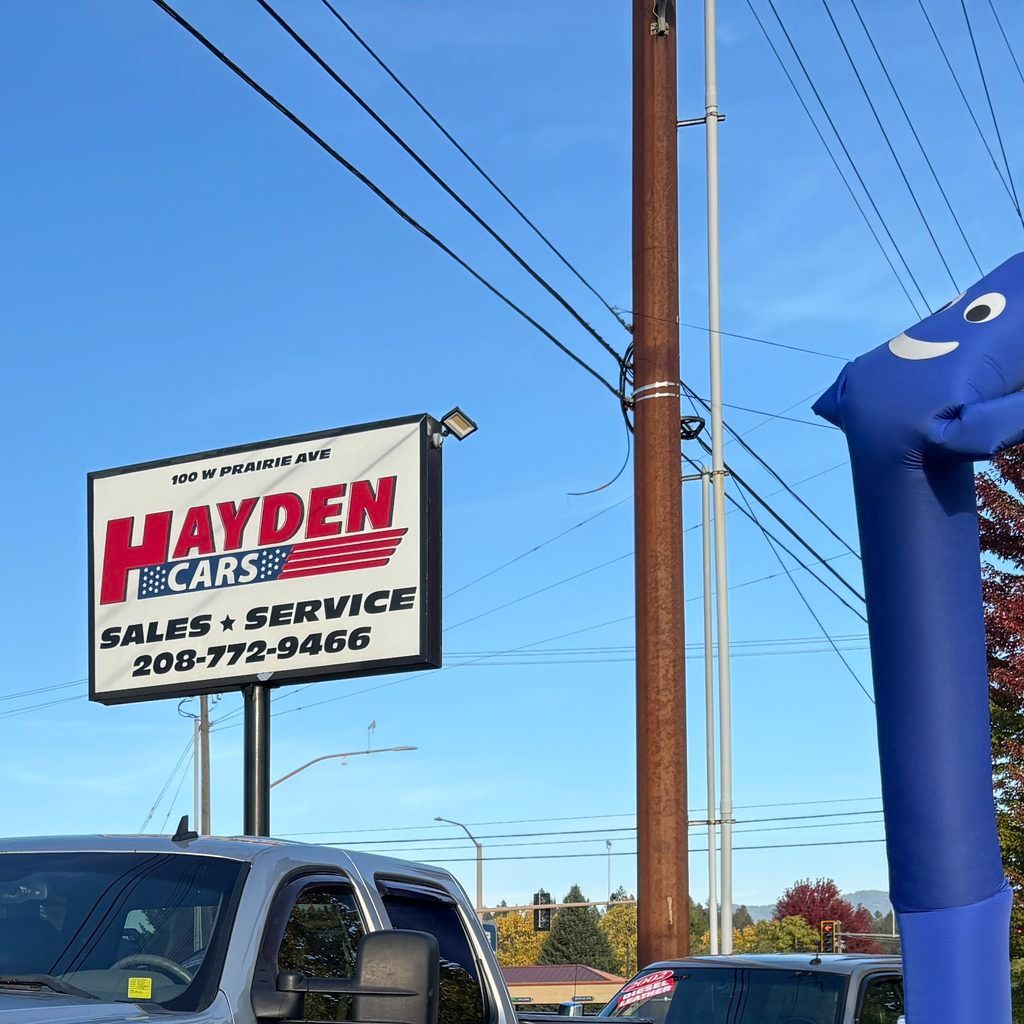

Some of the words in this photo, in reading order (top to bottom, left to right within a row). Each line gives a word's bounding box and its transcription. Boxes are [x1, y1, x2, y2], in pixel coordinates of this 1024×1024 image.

[171, 470, 199, 485] 100
[202, 468, 218, 481] W
[219, 456, 293, 478] PRAIRIE
[294, 448, 332, 463] AVE
[100, 475, 398, 605] HAYDEN
[167, 553, 259, 592] CARS
[99, 614, 213, 649] SALES
[244, 586, 417, 630] SERVICE
[132, 626, 372, 677] 208-772-9466
[619, 985, 672, 1007] LEATHER
[623, 979, 670, 1000] DIESEL
